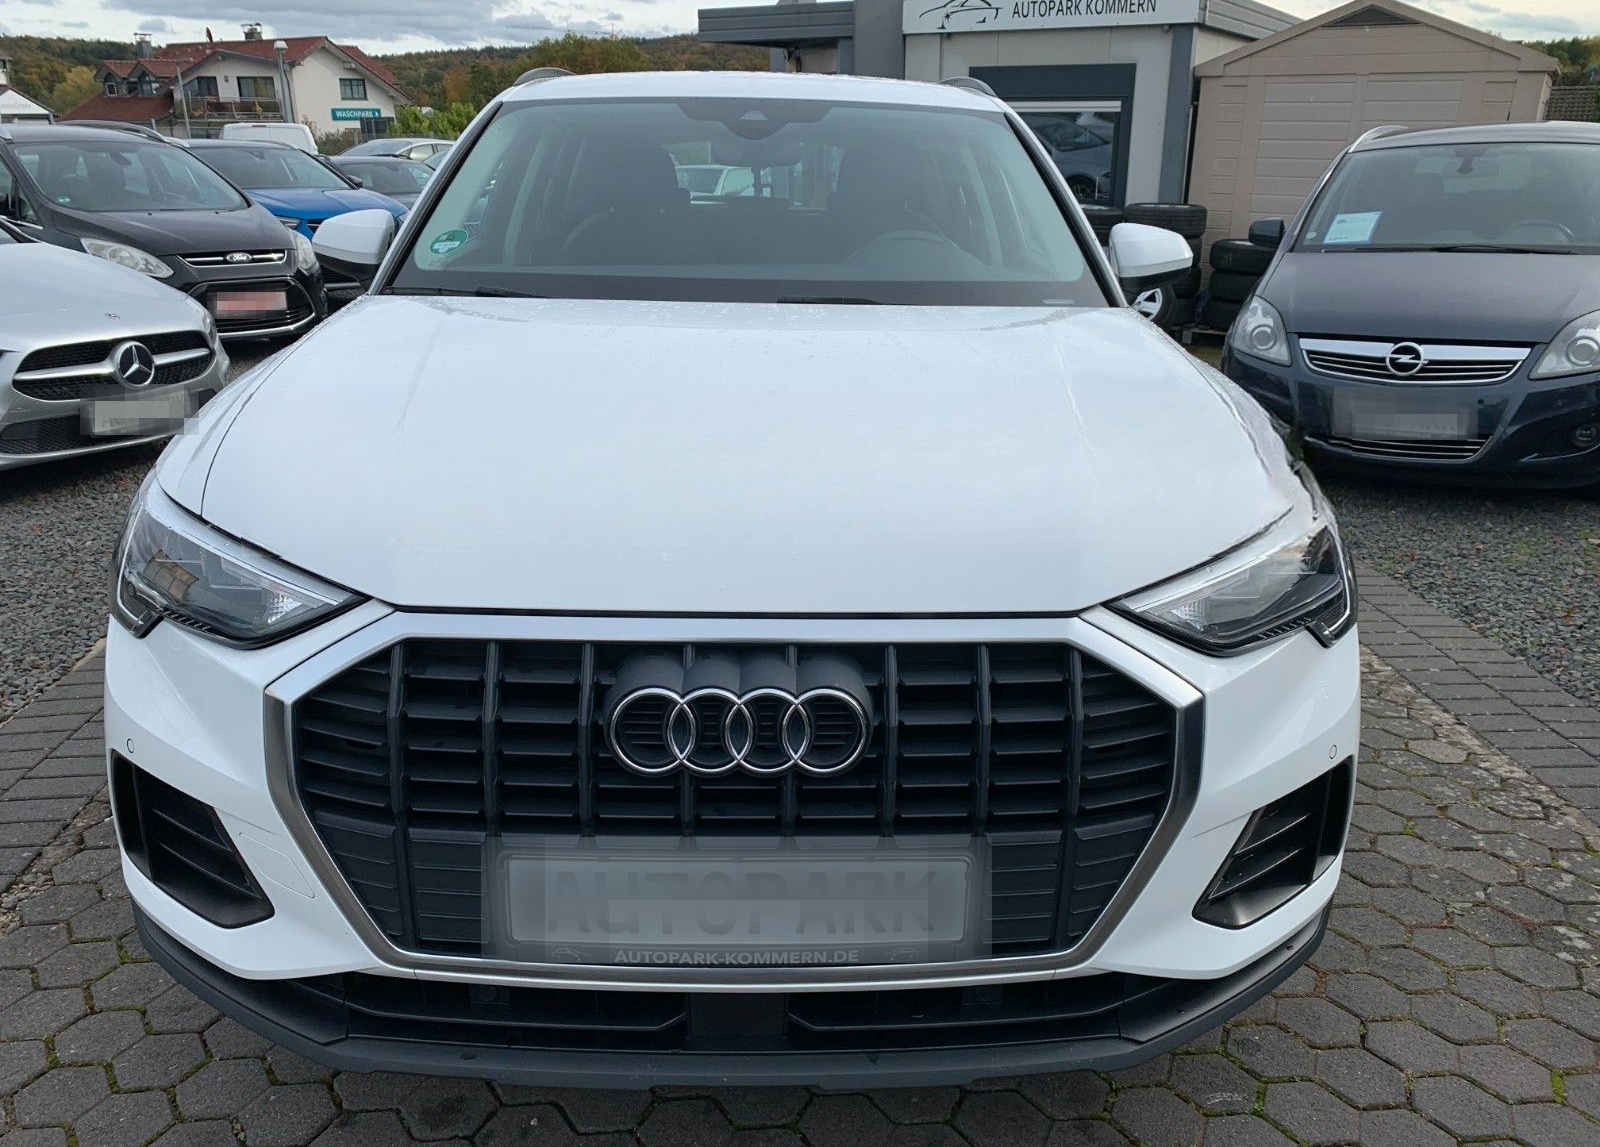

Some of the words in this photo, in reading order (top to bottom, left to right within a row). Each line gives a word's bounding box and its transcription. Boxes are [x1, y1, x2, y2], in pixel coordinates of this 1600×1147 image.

[1012, 0, 1082, 19] AUTOPARK
[1086, 0, 1156, 15] KOMMERN
[336, 110, 373, 118] WASCHPARK
[547, 871, 938, 934] AUTOPARK
[614, 950, 859, 965] AUTOPARK-KOMMERN.DE
